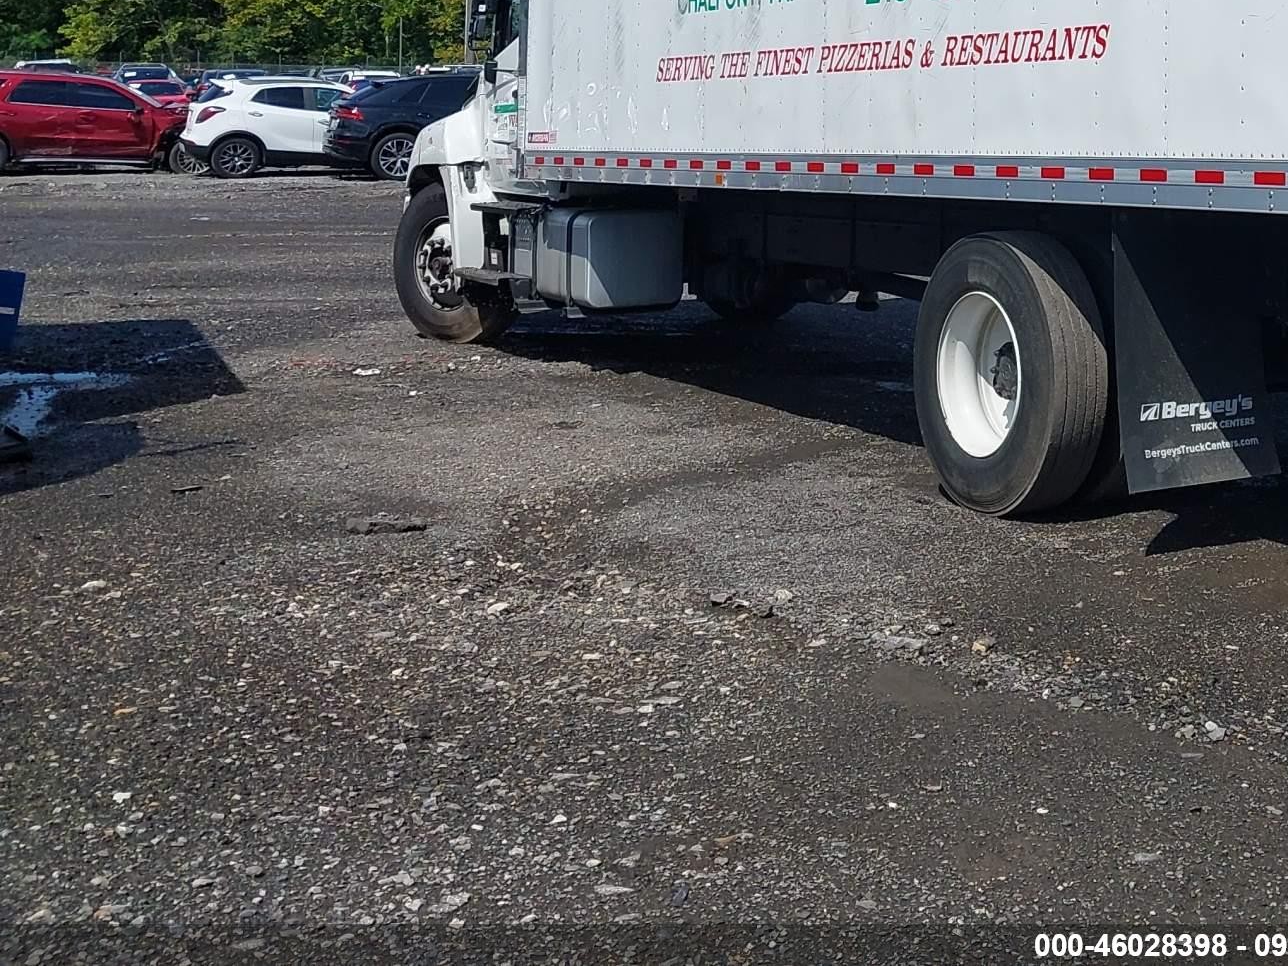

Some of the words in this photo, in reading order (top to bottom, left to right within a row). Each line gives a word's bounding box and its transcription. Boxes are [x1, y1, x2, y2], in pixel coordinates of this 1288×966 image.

[656, 55, 715, 82] SERVING
[720, 51, 751, 79] THE
[754, 47, 814, 77] FINEST
[816, 39, 916, 74] PIZZERIAS
[920, 40, 935, 68] &
[941, 24, 1110, 67] RESTAURANTS
[1161, 394, 1253, 420] Bergey's
[1190, 421, 1219, 433] TRUCK
[1219, 417, 1256, 429] CENTERS
[1144, 437, 1259, 459] BergeysTruckCenters.com
